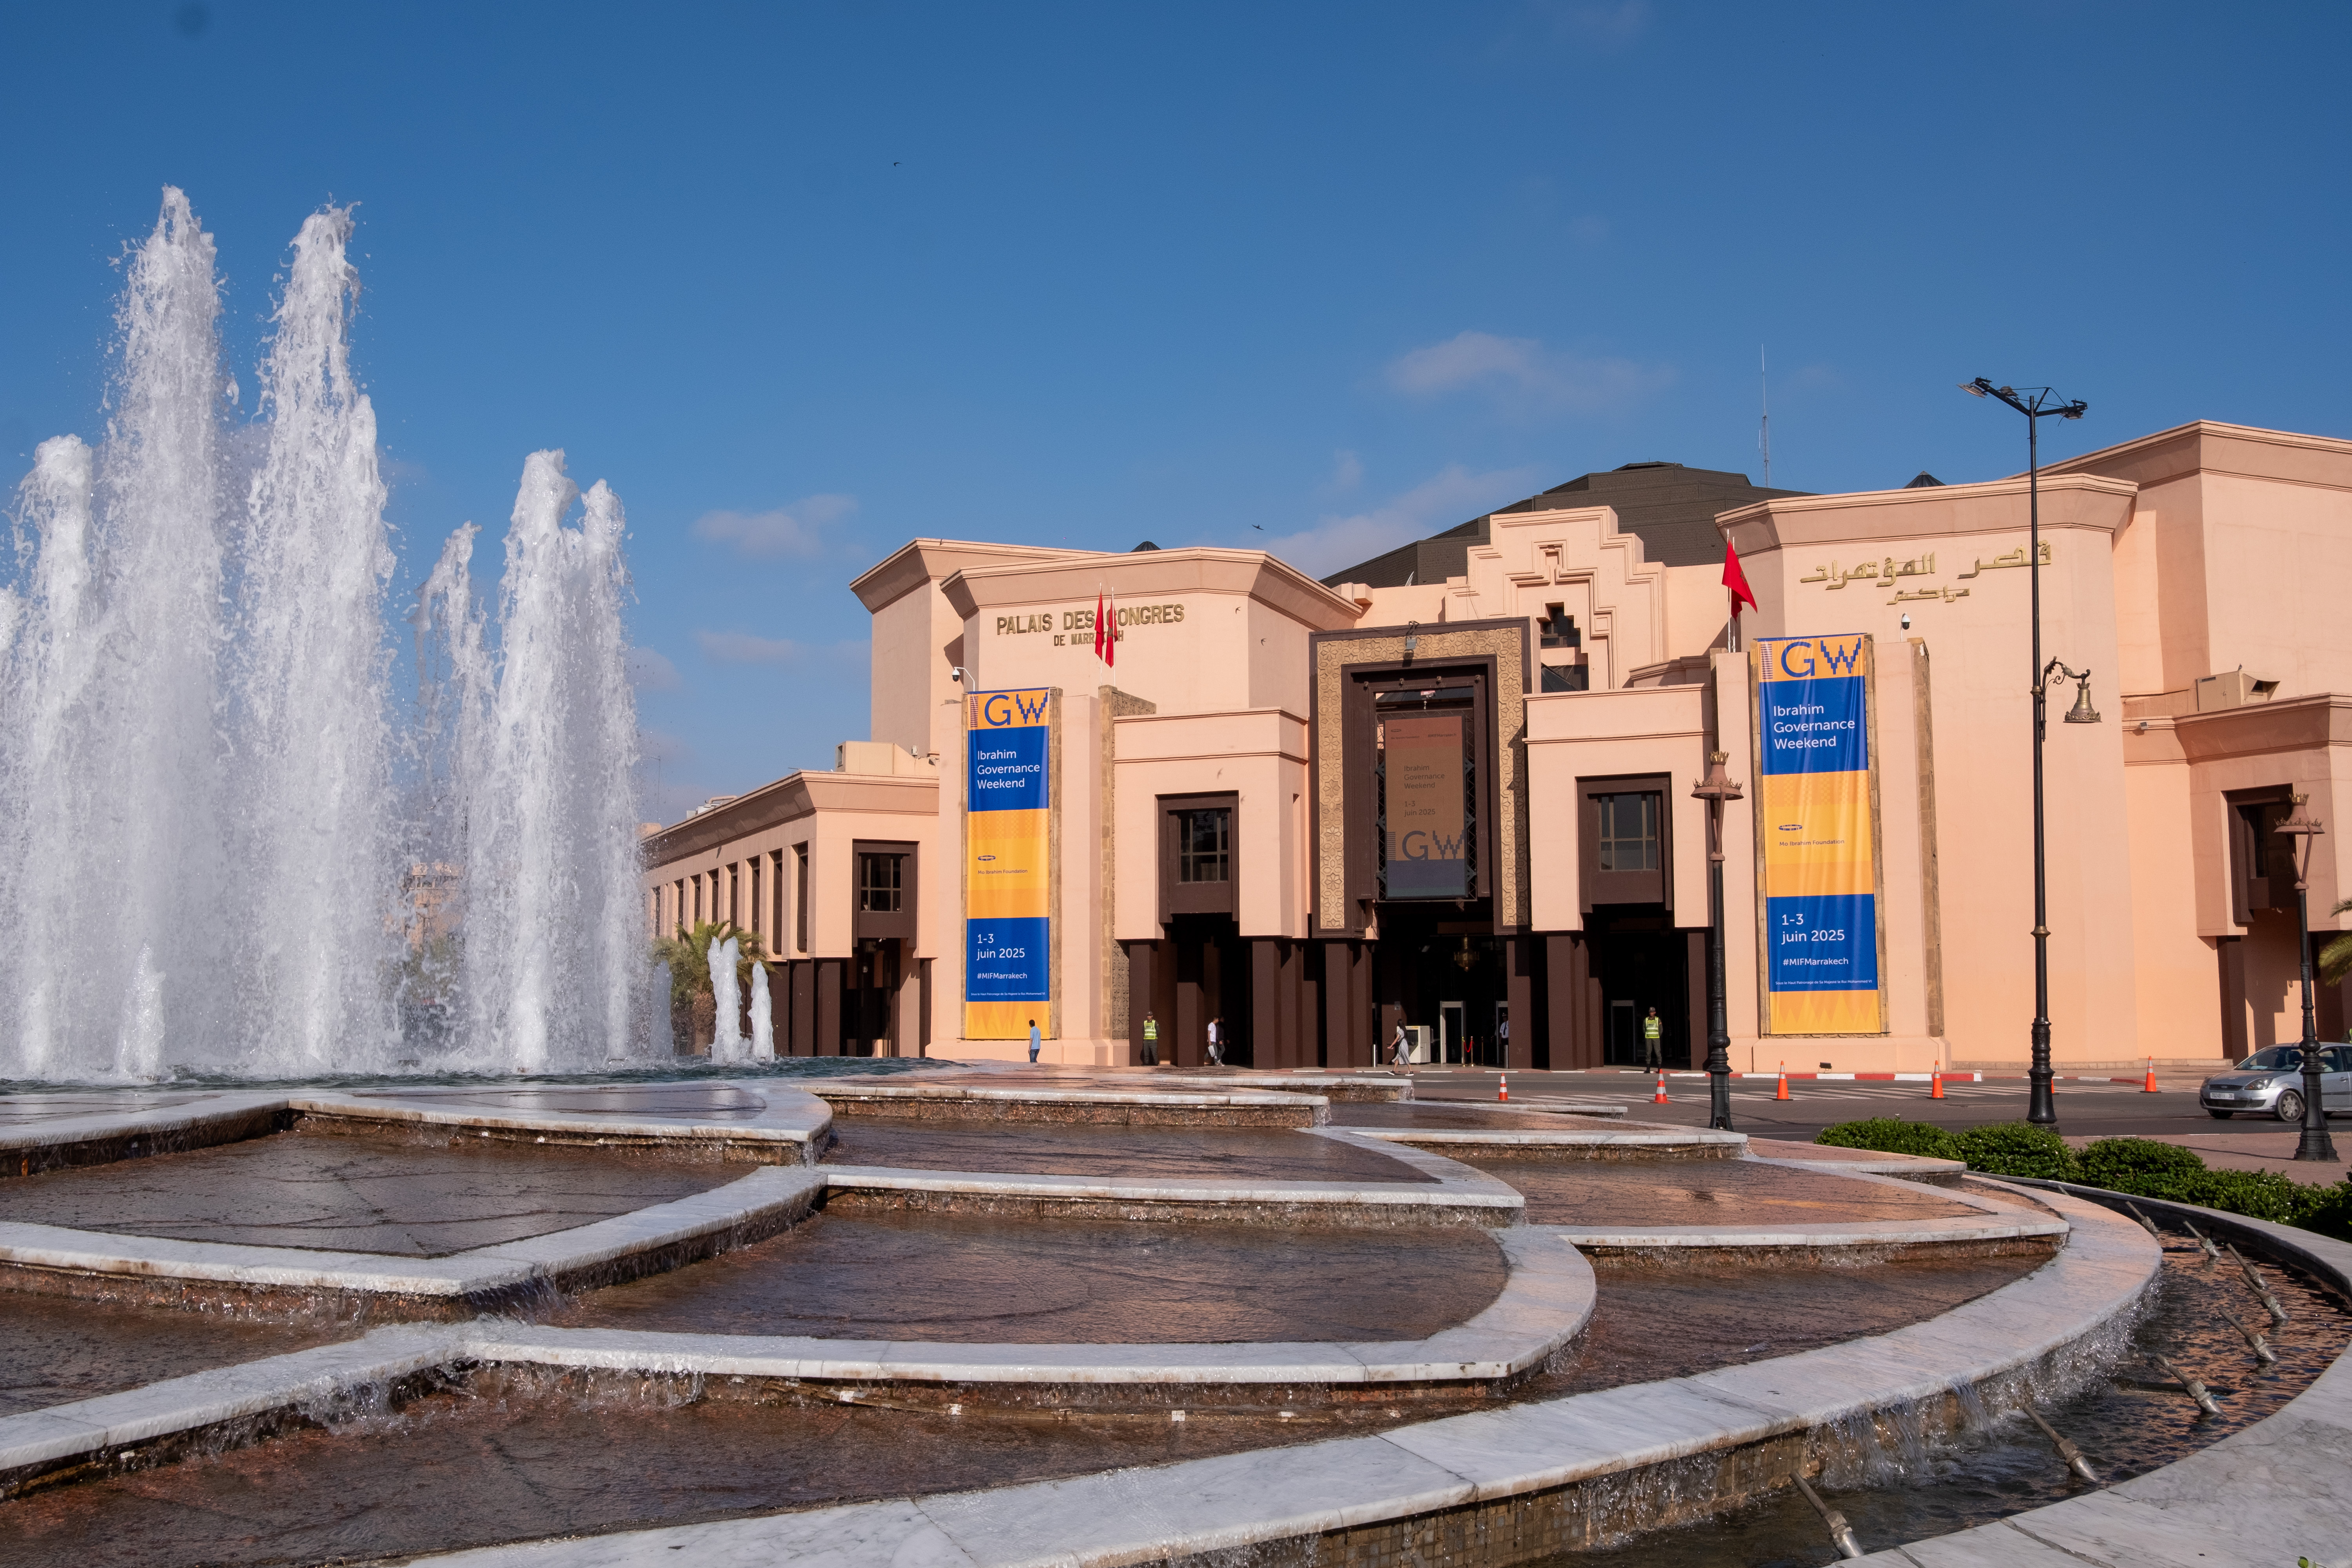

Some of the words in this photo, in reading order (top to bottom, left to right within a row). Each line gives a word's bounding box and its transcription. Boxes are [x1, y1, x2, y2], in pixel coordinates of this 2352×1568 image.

[1800, 551, 1935, 590] المؤتمرات
[1886, 585, 1970, 606] مراكش
[997, 613, 1053, 635] PALAIS
[1063, 610, 1095, 630] DES
[1054, 634, 1066, 646] DE
[1773, 704, 1824, 717] Ibrahim
[1773, 720, 1855, 733] Governance
[1774, 735, 1837, 750] Weekend
[977, 749, 1016, 760] Ibrahim
[977, 764, 1040, 775] Governance
[977, 778, 1025, 789] Weekend
[1782, 913, 1804, 926] 1-3
[977, 933, 994, 944] 1-3
[1781, 931, 1807, 945] juin
[1811, 929, 1845, 941] 2025
[976, 948, 996, 961] juin
[999, 948, 1025, 958] 2025
[1782, 957, 1849, 966] #MIFMarrakech
